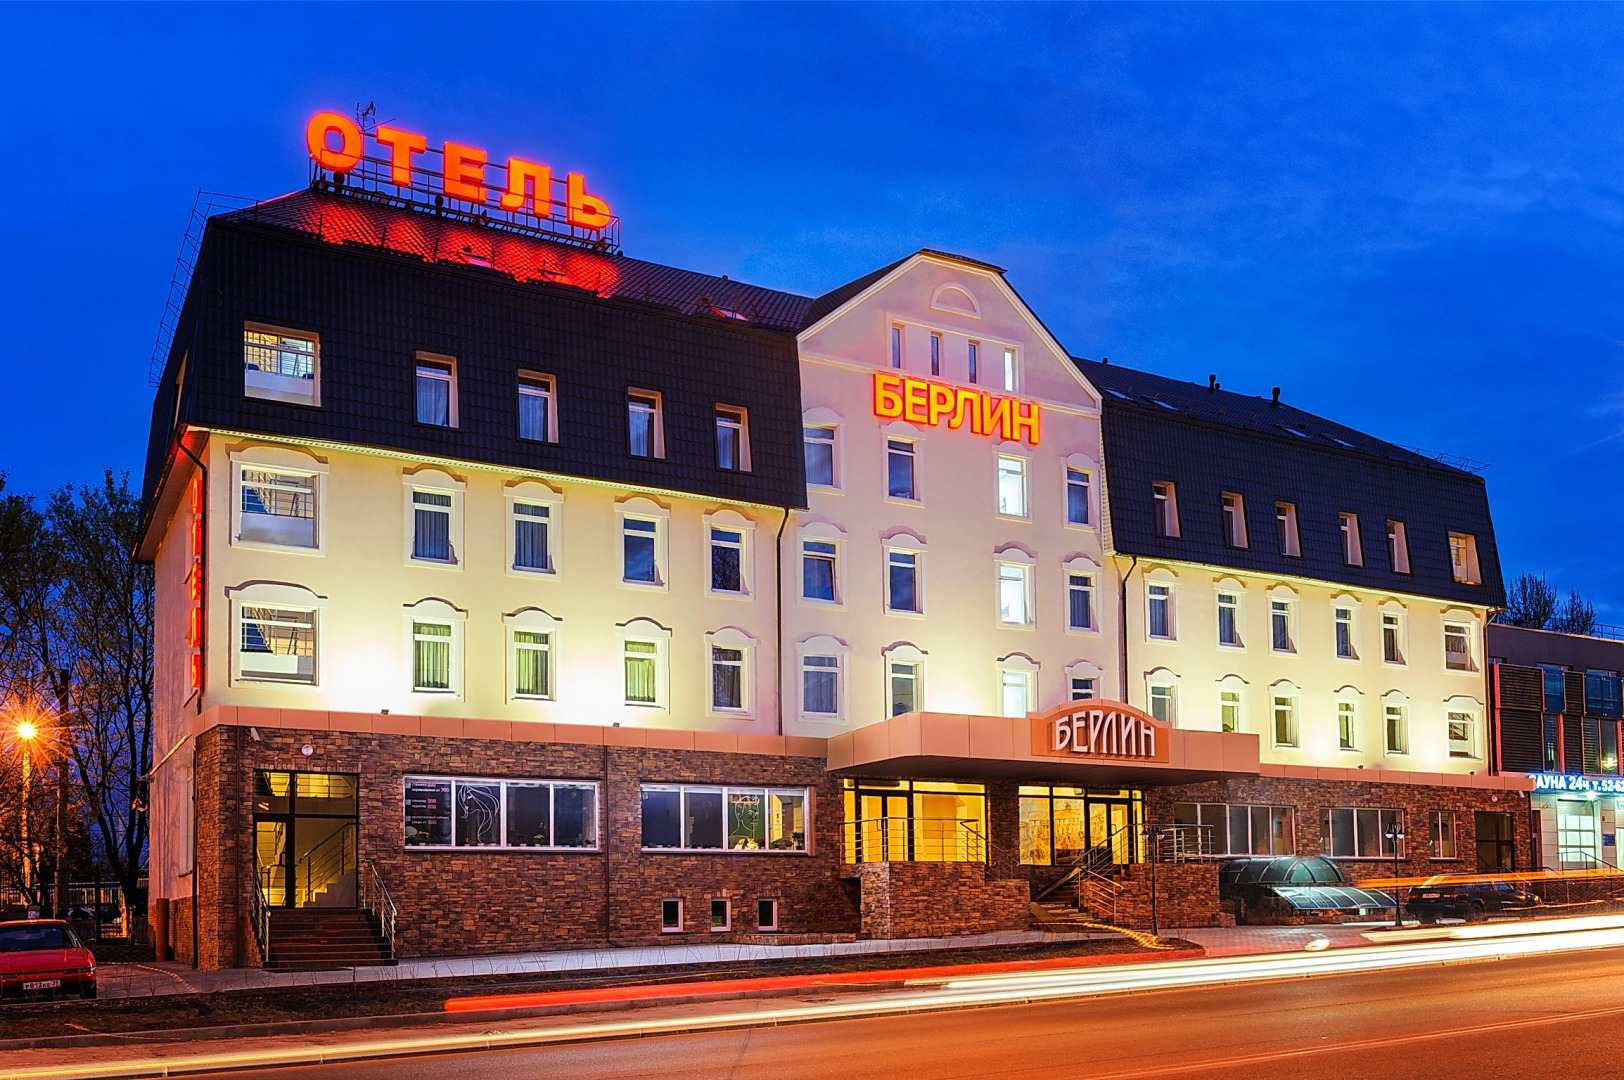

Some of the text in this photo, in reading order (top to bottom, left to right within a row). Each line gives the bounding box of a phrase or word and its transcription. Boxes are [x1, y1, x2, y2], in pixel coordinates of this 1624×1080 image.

[306, 112, 610, 231] ОТЕЛЬ
[873, 372, 1040, 445] БЕРЛИН
[1051, 710, 1155, 757] БЕРЛИН
